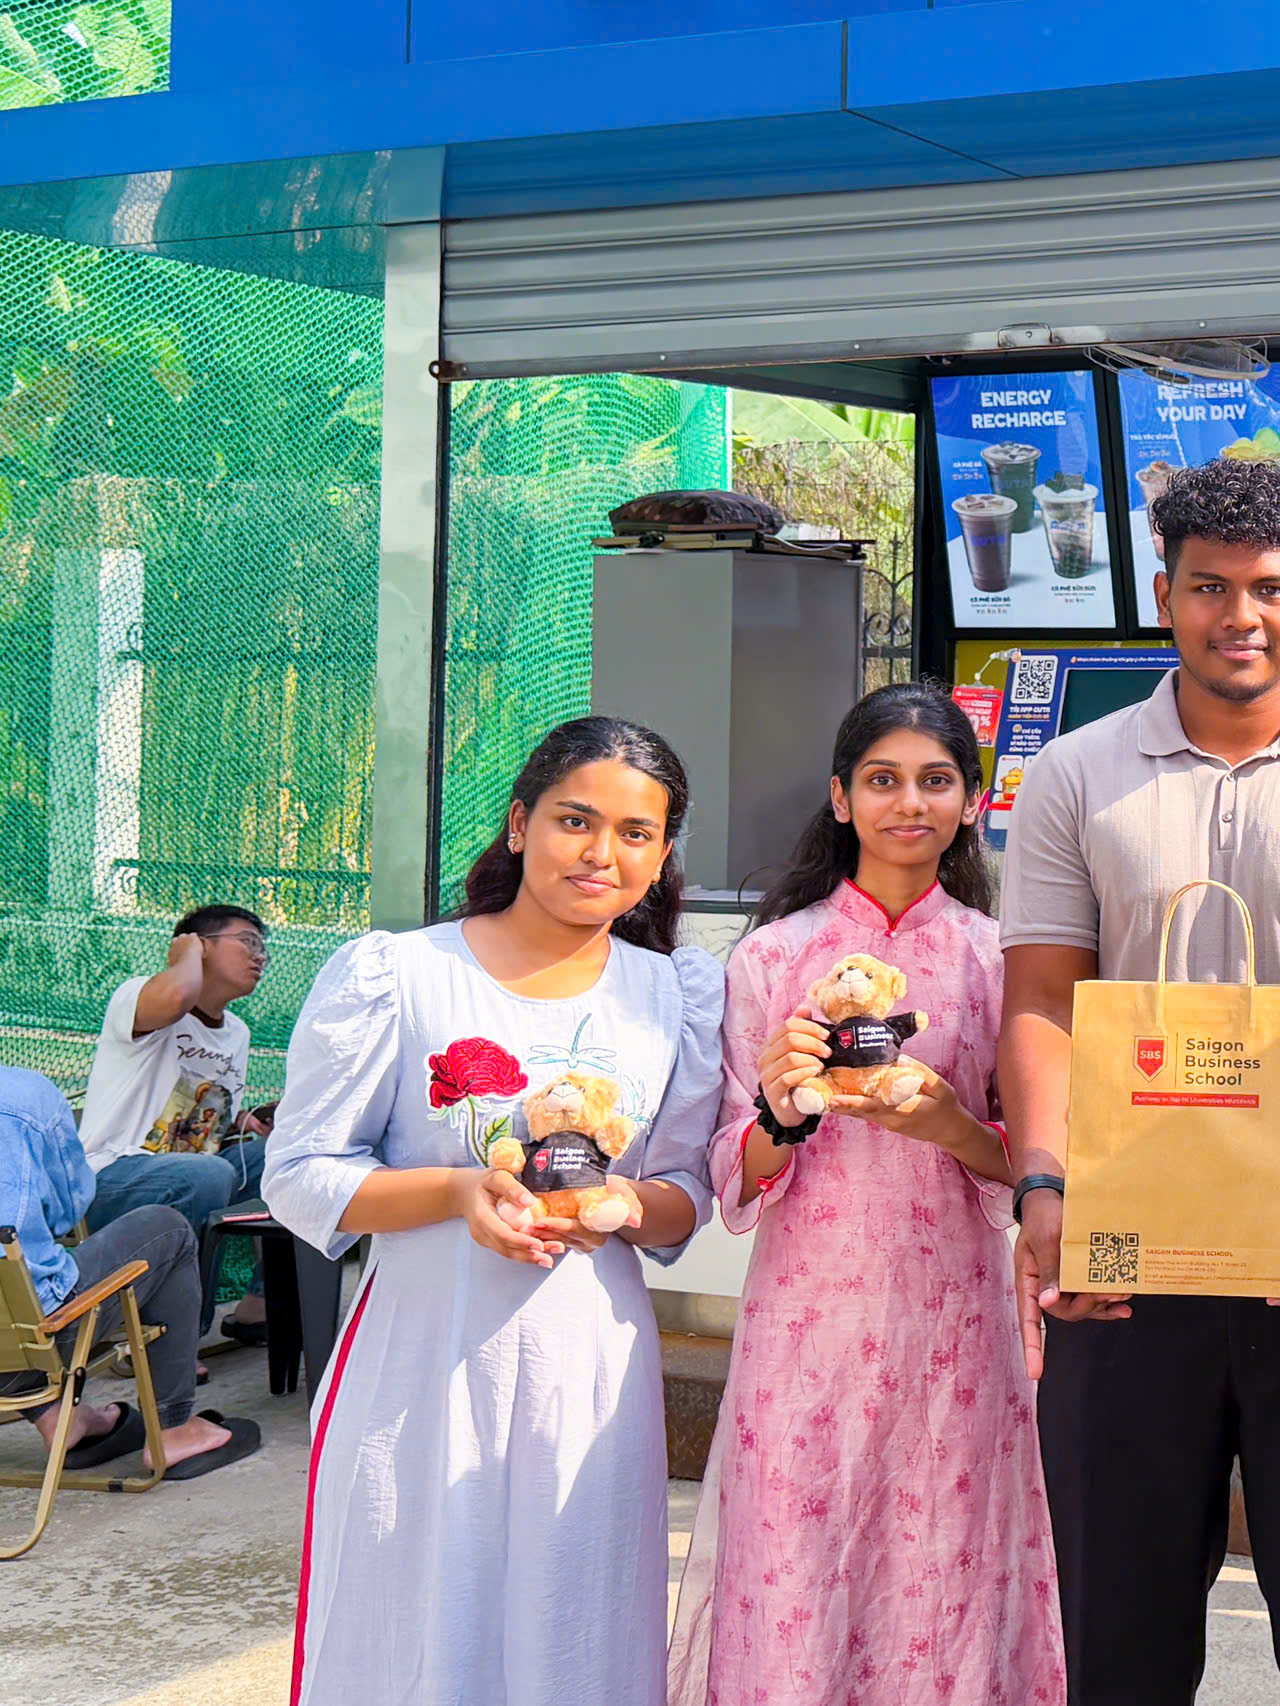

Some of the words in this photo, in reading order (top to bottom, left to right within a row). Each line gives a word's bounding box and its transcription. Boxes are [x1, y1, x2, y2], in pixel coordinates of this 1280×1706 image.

[980, 389, 1052, 408] ENERGY
[1157, 381, 1243, 400] REFRESH
[971, 410, 1067, 429] RECHARGE
[1156, 405, 1207, 422] YOUR
[1210, 403, 1247, 420] DAY
[1186, 1037, 1244, 1054] Saigon
[1140, 1050, 1161, 1060] SBS
[1185, 1055, 1261, 1069] Business
[1185, 1072, 1242, 1086] School
[555, 1146, 585, 1156] Saigon
